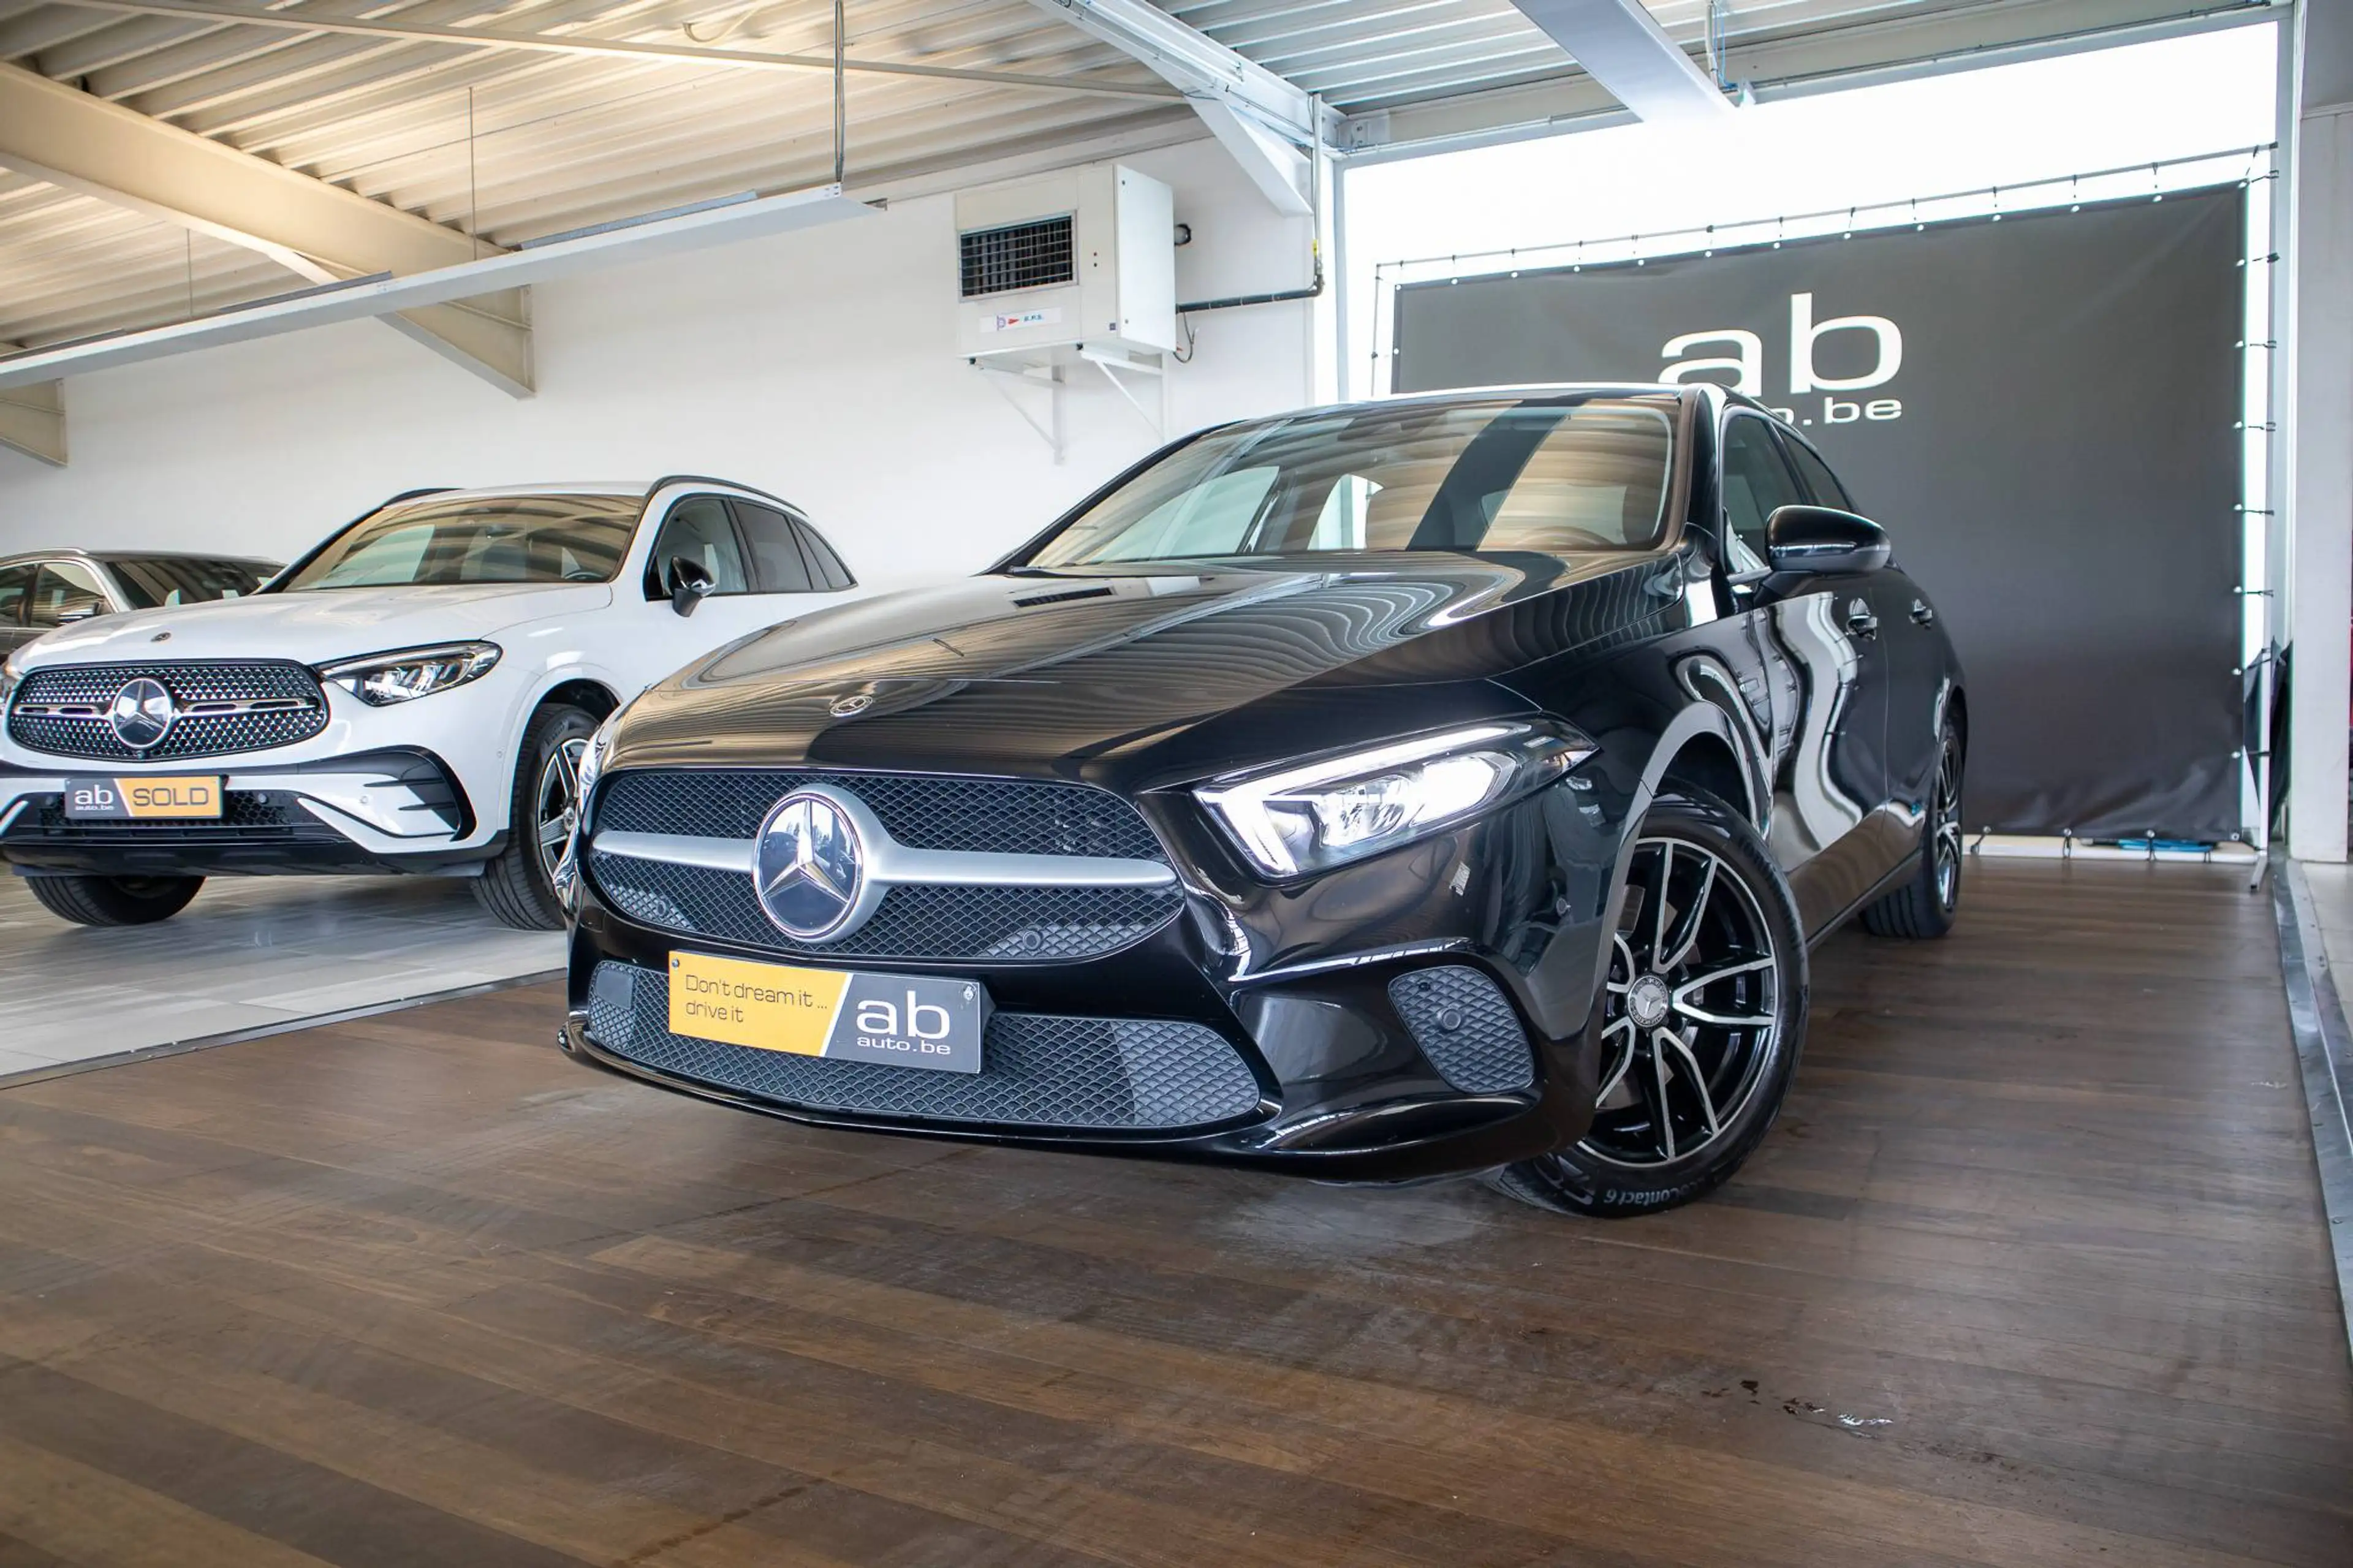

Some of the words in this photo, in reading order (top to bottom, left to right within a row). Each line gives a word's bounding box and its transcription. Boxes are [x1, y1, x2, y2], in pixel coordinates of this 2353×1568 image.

[1658, 292, 1903, 398] ab
[74, 784, 113, 805] ab
[132, 787, 209, 806] SOLD
[685, 974, 730, 996] Don't
[733, 983, 794, 1006] dream
[798, 990, 813, 1007] it
[686, 1000, 727, 1020] drive
[731, 1006, 744, 1023] it
[857, 990, 950, 1039] ab
[857, 1037, 951, 1055] auto.be
[1603, 1189, 1618, 1204] 6
